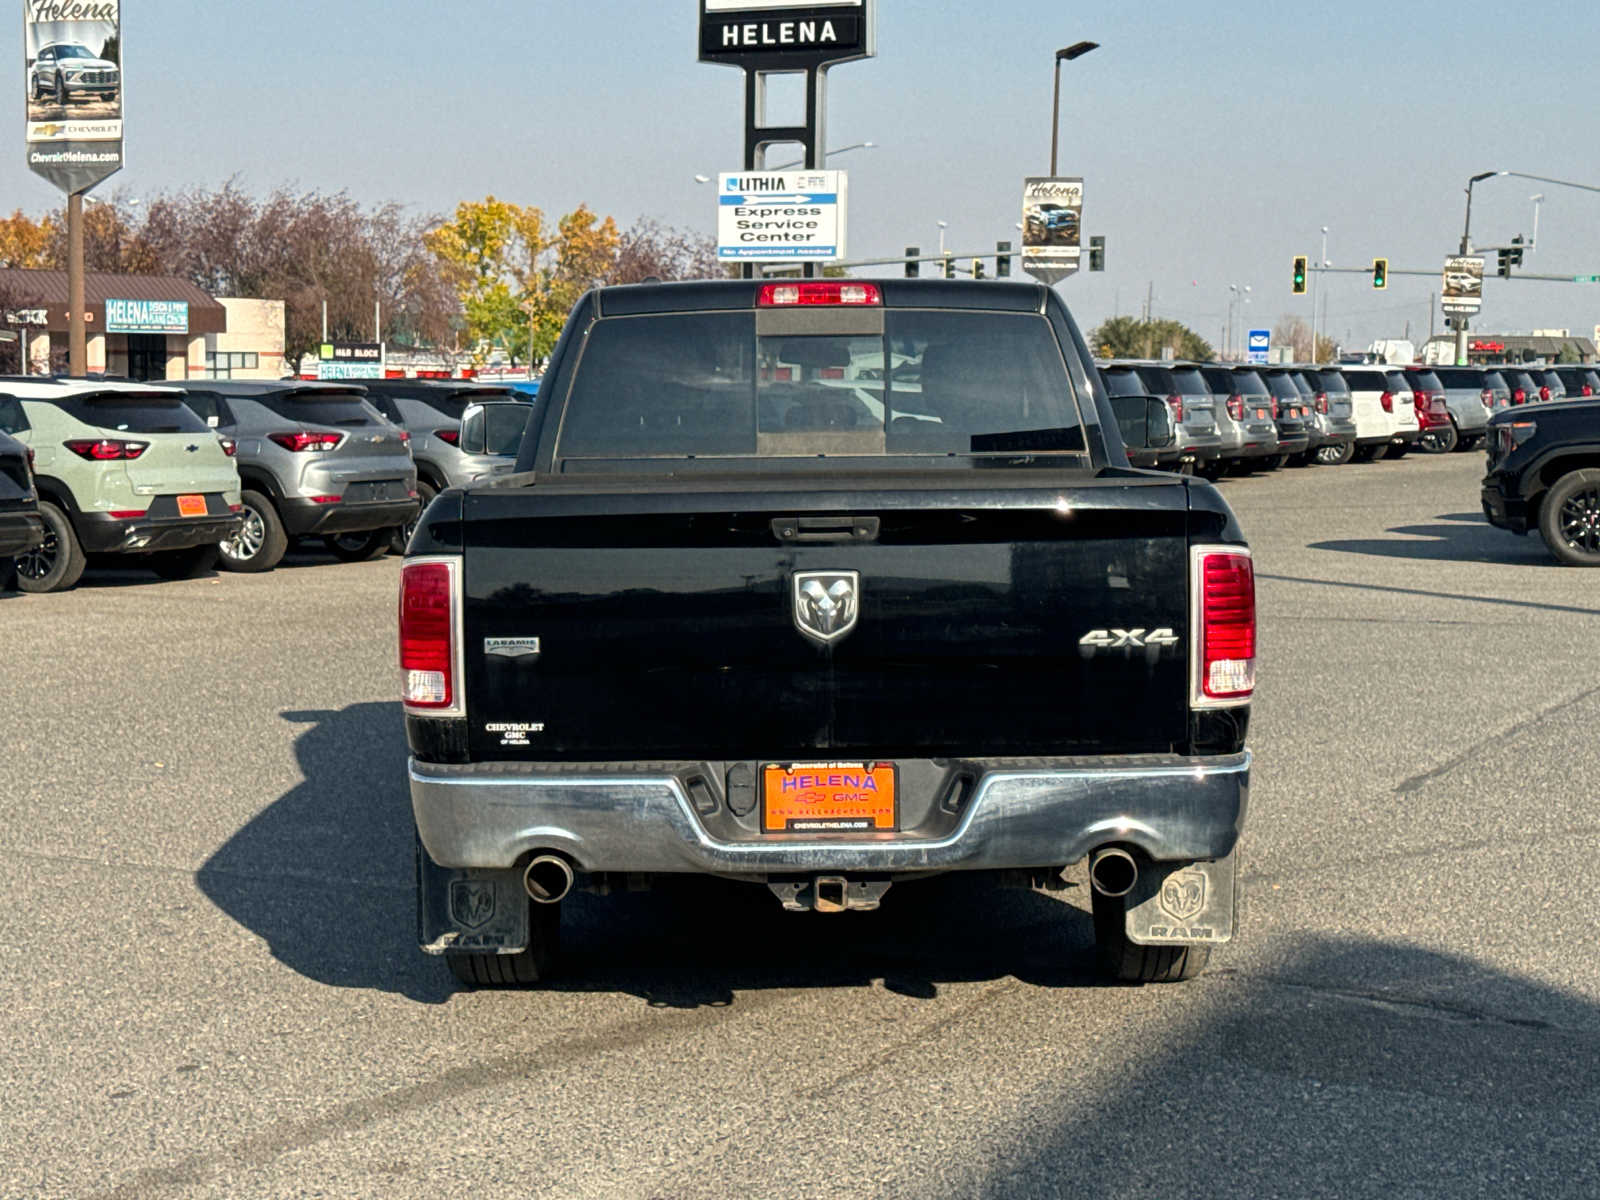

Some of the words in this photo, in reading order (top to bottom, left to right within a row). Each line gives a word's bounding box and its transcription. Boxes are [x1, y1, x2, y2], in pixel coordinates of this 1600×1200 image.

[32, 0, 118, 22] Helena
[722, 21, 837, 46] HELENA
[739, 177, 786, 191] LITHIA
[734, 207, 822, 218] Express
[736, 220, 818, 230] Service
[740, 232, 815, 242] Center
[107, 301, 149, 323] HELENA
[335, 348, 352, 357] H&R
[485, 723, 545, 731] CHEVROLET
[504, 731, 526, 739] GMC
[781, 775, 878, 793] HELENA
[832, 793, 869, 802] GMC
[1150, 926, 1213, 938] RAM
